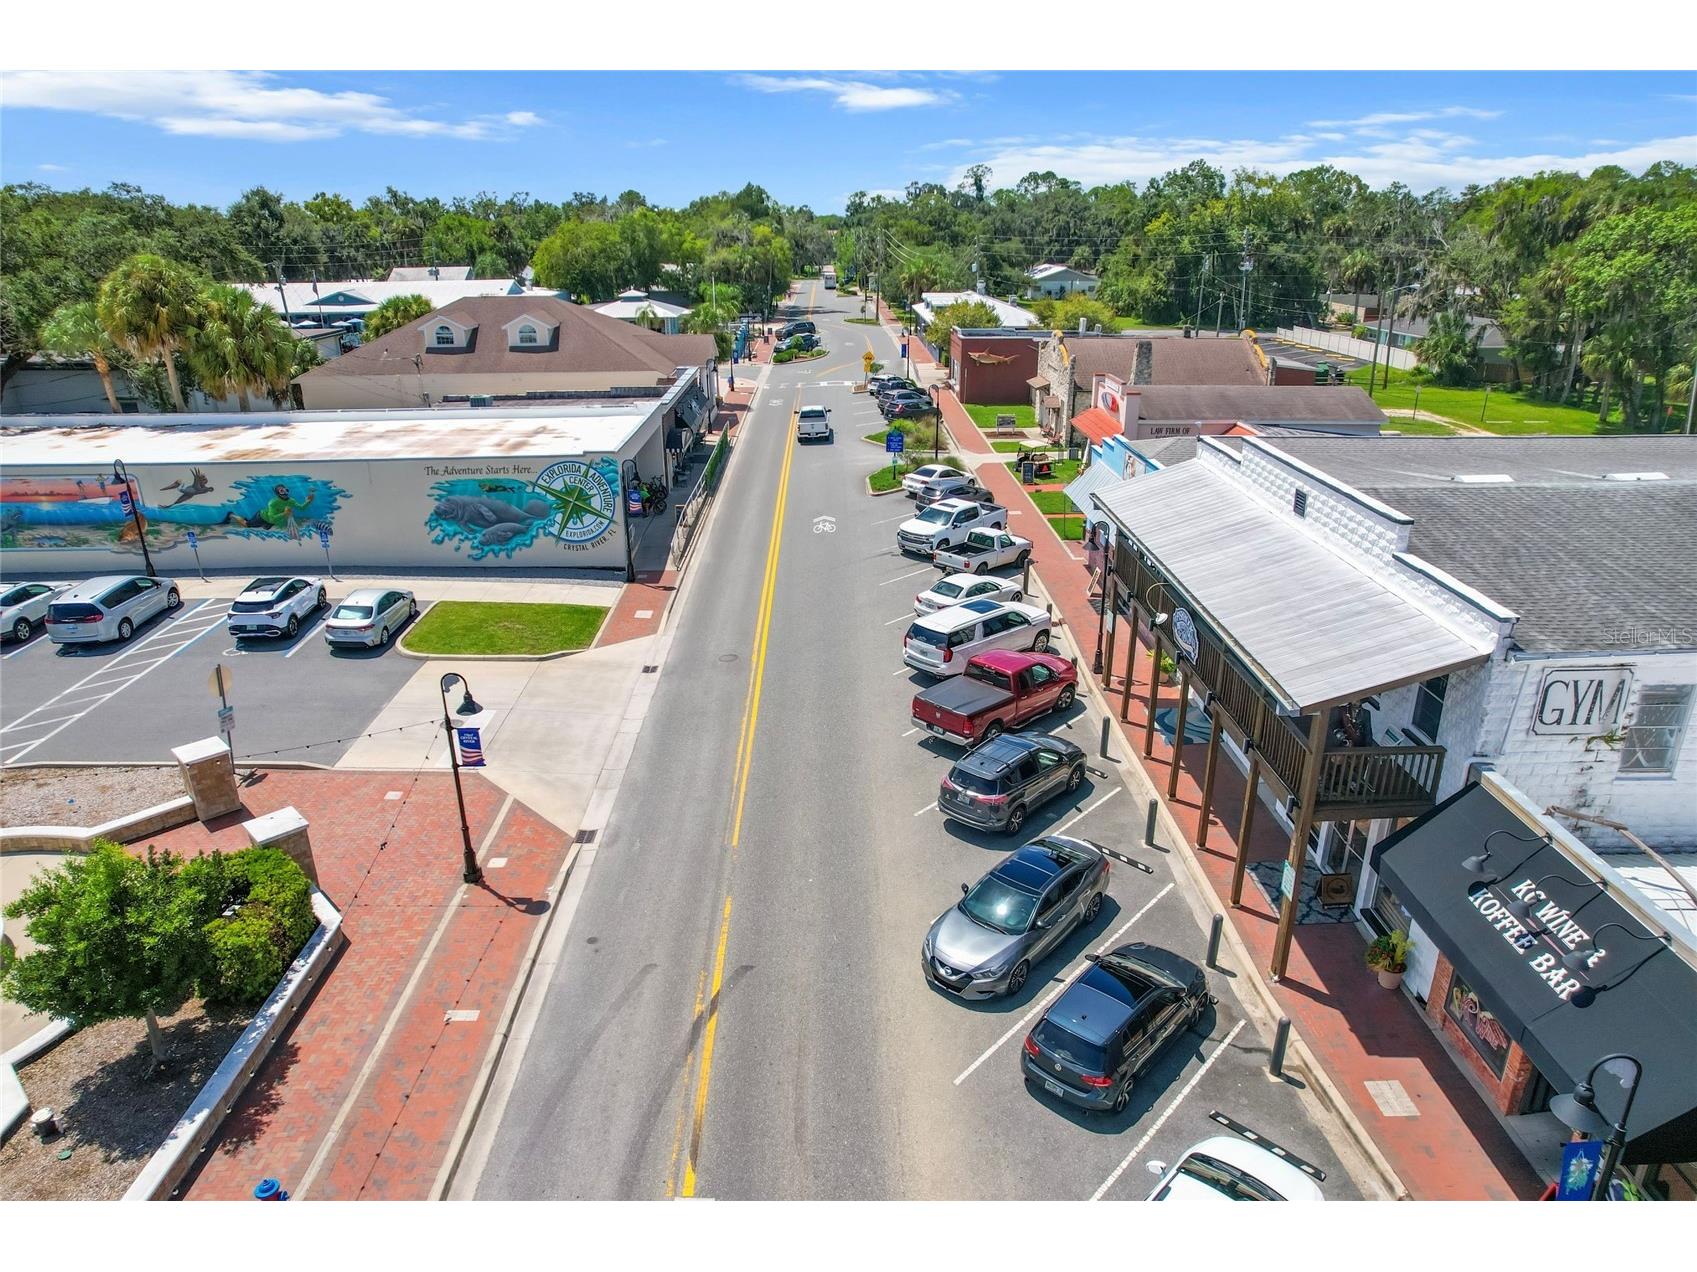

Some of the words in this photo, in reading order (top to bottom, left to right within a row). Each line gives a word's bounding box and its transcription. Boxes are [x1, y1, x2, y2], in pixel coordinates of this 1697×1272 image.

[1150, 427, 1164, 435] LAW
[424, 464, 438, 476] The
[438, 464, 483, 476] Adventure
[485, 463, 510, 474] Starts
[541, 463, 582, 485] EXPLORIDA
[589, 472, 613, 514] ADVENTURE
[568, 476, 595, 493] CENTER
[563, 543, 589, 552] CRYSTAL
[608, 528, 617, 537] FL
[565, 520, 605, 539] EXPLORIDA.COM
[1538, 679, 1626, 726] GYM
[1468, 887, 1539, 956] KOFFEE
[1529, 952, 1582, 1001] BAR
